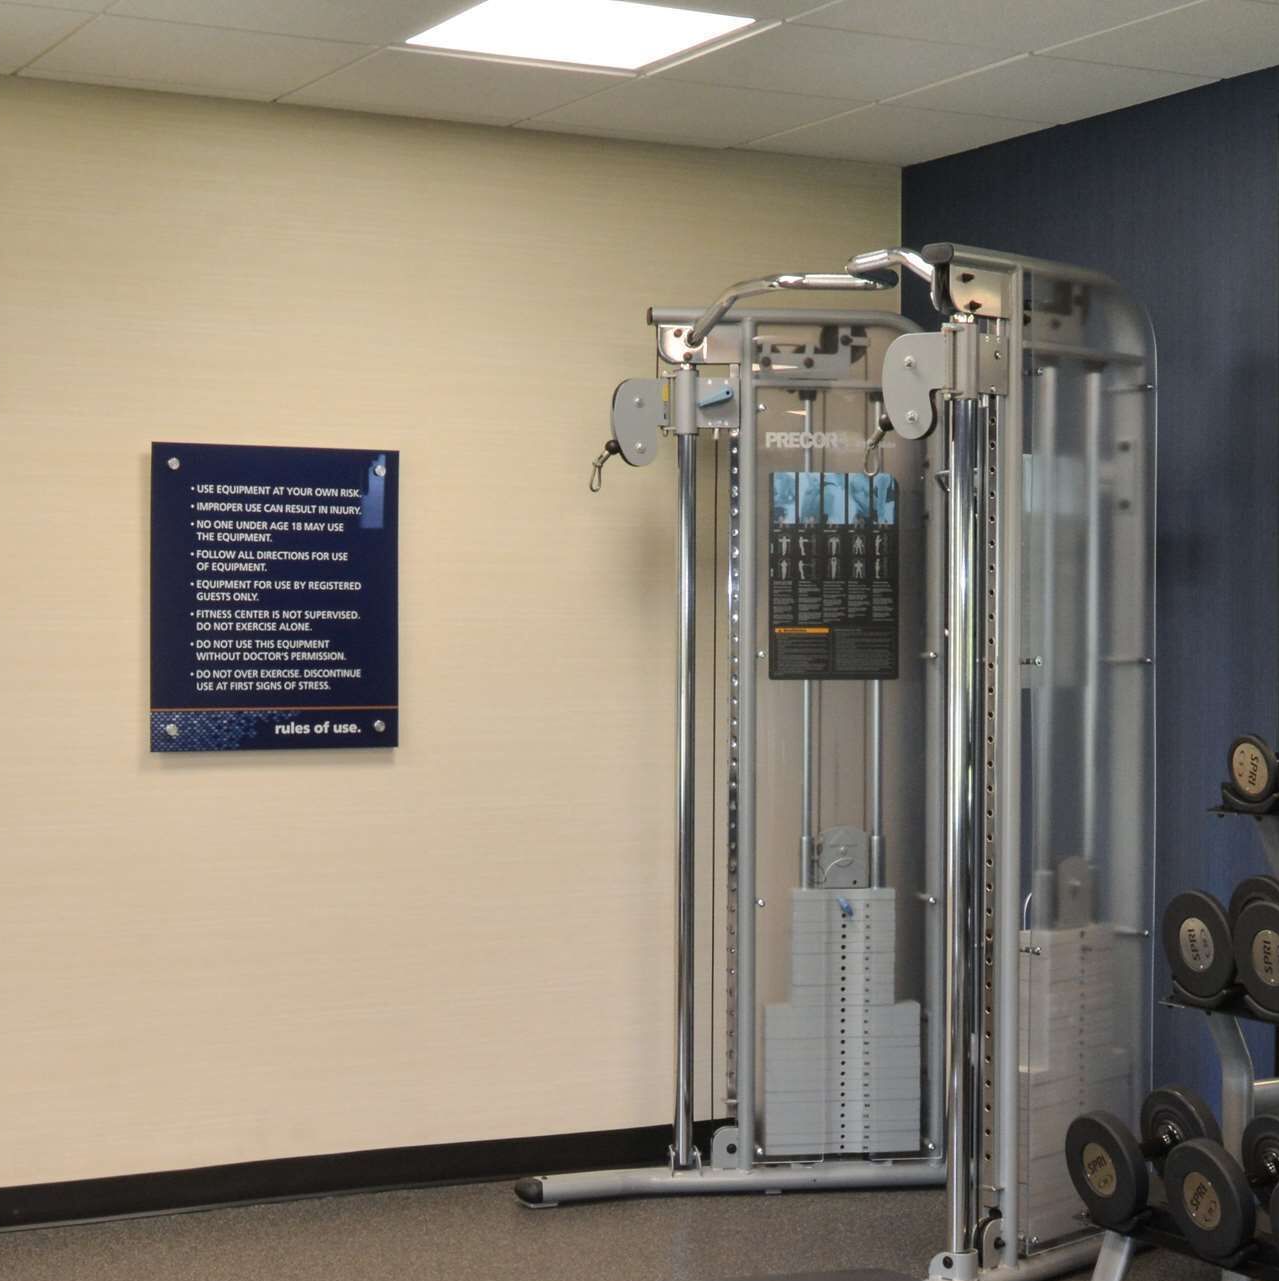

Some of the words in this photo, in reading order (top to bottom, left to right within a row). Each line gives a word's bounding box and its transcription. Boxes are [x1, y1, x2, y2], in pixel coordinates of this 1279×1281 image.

[765, 431, 838, 449] PRECOR
[196, 484, 214, 494] USE
[216, 485, 270, 496] EQUIPMENT
[272, 486, 284, 496] AT
[286, 486, 312, 496] YOUR
[314, 487, 338, 497] OWN
[340, 487, 361, 497] RISK.
[196, 503, 243, 513] IMPROPER
[244, 503, 261, 513] USE
[263, 504, 283, 514] CAN
[285, 504, 316, 514] RESULT
[318, 504, 328, 514] IN
[329, 505, 361, 515] INJURY.
[196, 520, 211, 530] NO
[213, 521, 233, 530] ONE
[235, 521, 267, 531] UNDER
[269, 521, 288, 531] AGE
[291, 522, 302, 531] 18
[303, 522, 325, 532] MAY
[327, 522, 343, 532] USE
[196, 533, 214, 542] THE
[216, 533, 272, 543] EQUIPMENT.
[196, 550, 236, 560] FOLLOW
[237, 551, 254, 560] ALL
[256, 551, 309, 561] DIRECTIONS
[311, 552, 329, 561] FOR
[331, 552, 347, 561] USE
[196, 563, 209, 572] OF
[211, 563, 267, 572] EQUIPMENT.
[196, 580, 251, 590] EQUIPMENT
[253, 581, 272, 590] FOR
[274, 581, 291, 590] USE
[293, 581, 306, 590] BY
[308, 581, 361, 590] REGISTERED
[196, 592, 231, 602] GUESTS
[232, 592, 258, 602] ONLY.
[196, 610, 232, 619] FITNESS
[234, 610, 269, 619] CENTER
[272, 610, 280, 620] IS
[282, 610, 302, 620] NOT
[304, 610, 360, 620] SUPERVISED.
[196, 622, 211, 631] DO
[213, 622, 233, 631] NOT
[235, 622, 276, 631] EXERCISE
[278, 622, 312, 631] ALONE.
[196, 640, 211, 649] DO
[213, 640, 233, 649] NOT
[235, 640, 252, 649] USE
[254, 640, 275, 649] THIS
[276, 640, 329, 649] EQUIPMENT
[195, 652, 240, 661] WITHOUT
[242, 652, 289, 661] DOCTOR'S
[290, 652, 345, 661] PERMISSION.
[196, 670, 211, 679] DO
[212, 670, 232, 679] NOT
[233, 670, 258, 679] OVER
[260, 669, 301, 679] EXERCISE.
[303, 669, 360, 679] DISCONTINUE
[196, 682, 213, 691] USE
[215, 682, 228, 691] AT
[229, 682, 253, 691] FIRST
[255, 682, 282, 691] SIGNS
[283, 682, 296, 690] OF
[298, 682, 329, 690] STRESS.
[274, 721, 310, 735] rules
[313, 721, 329, 735] of
[332, 720, 360, 735] use.
[1248, 754, 1259, 787] SPRI
[1187, 929, 1200, 961] SPRI
[1263, 940, 1274, 975] SPRI
[1087, 1154, 1106, 1174] SPRI
[1190, 1182, 1208, 1209] SPRI
